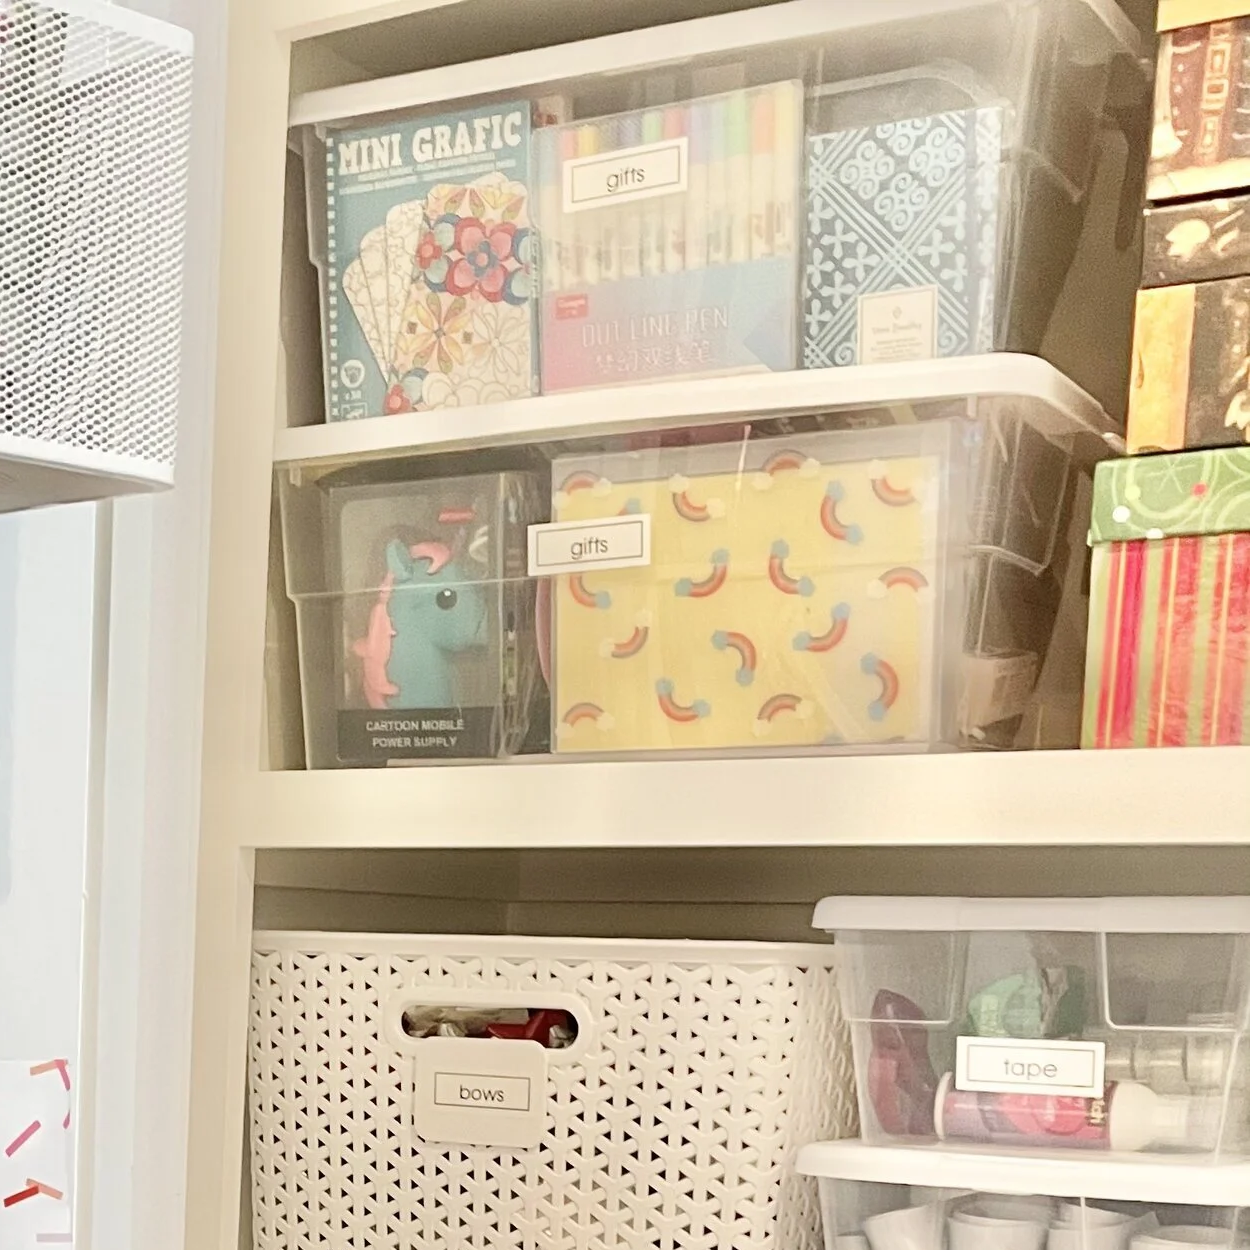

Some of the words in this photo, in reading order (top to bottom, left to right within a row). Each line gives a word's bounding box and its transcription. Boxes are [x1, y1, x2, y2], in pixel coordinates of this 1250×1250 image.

[338, 133, 403, 176] MINI
[412, 111, 522, 163] GRAFIC
[606, 166, 646, 192] gifts
[570, 536, 609, 560] gifts
[365, 720, 419, 731] CARTOON
[421, 718, 464, 731] MOBILE
[372, 736, 412, 748] POWER
[413, 736, 457, 748] SUPPLY
[1003, 1058, 1058, 1080] tape
[459, 1084, 505, 1102] bows
